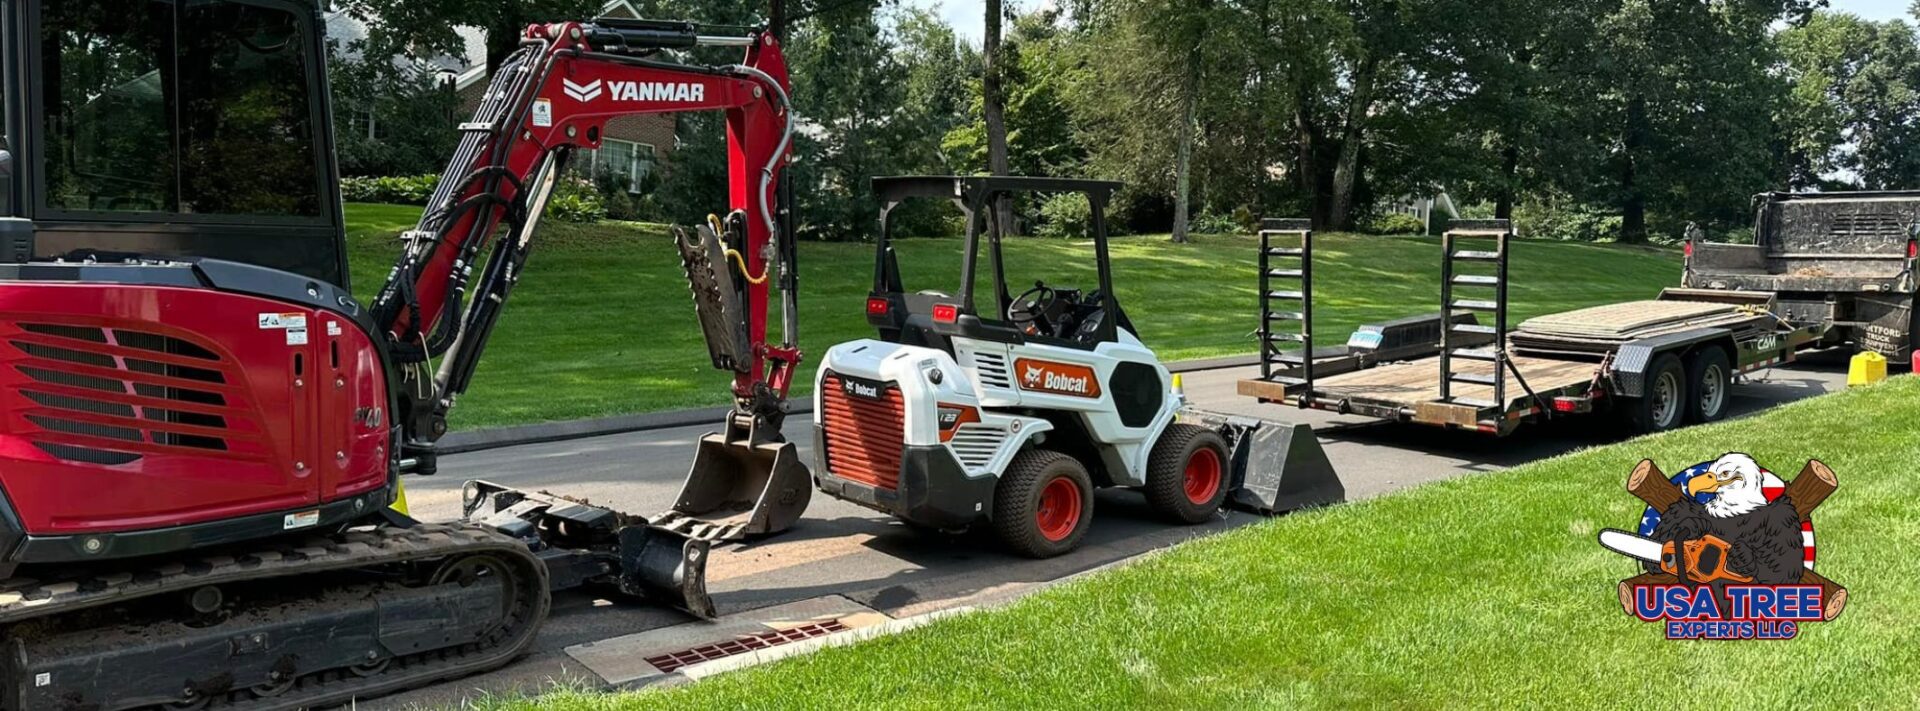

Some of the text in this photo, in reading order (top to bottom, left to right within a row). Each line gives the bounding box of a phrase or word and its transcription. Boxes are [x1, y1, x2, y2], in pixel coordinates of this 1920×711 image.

[607, 80, 704, 102] YANMAR
[1866, 331, 1890, 343] TRUCK
[855, 383, 877, 398] Bobcat
[1044, 371, 1088, 393] Bobcat
